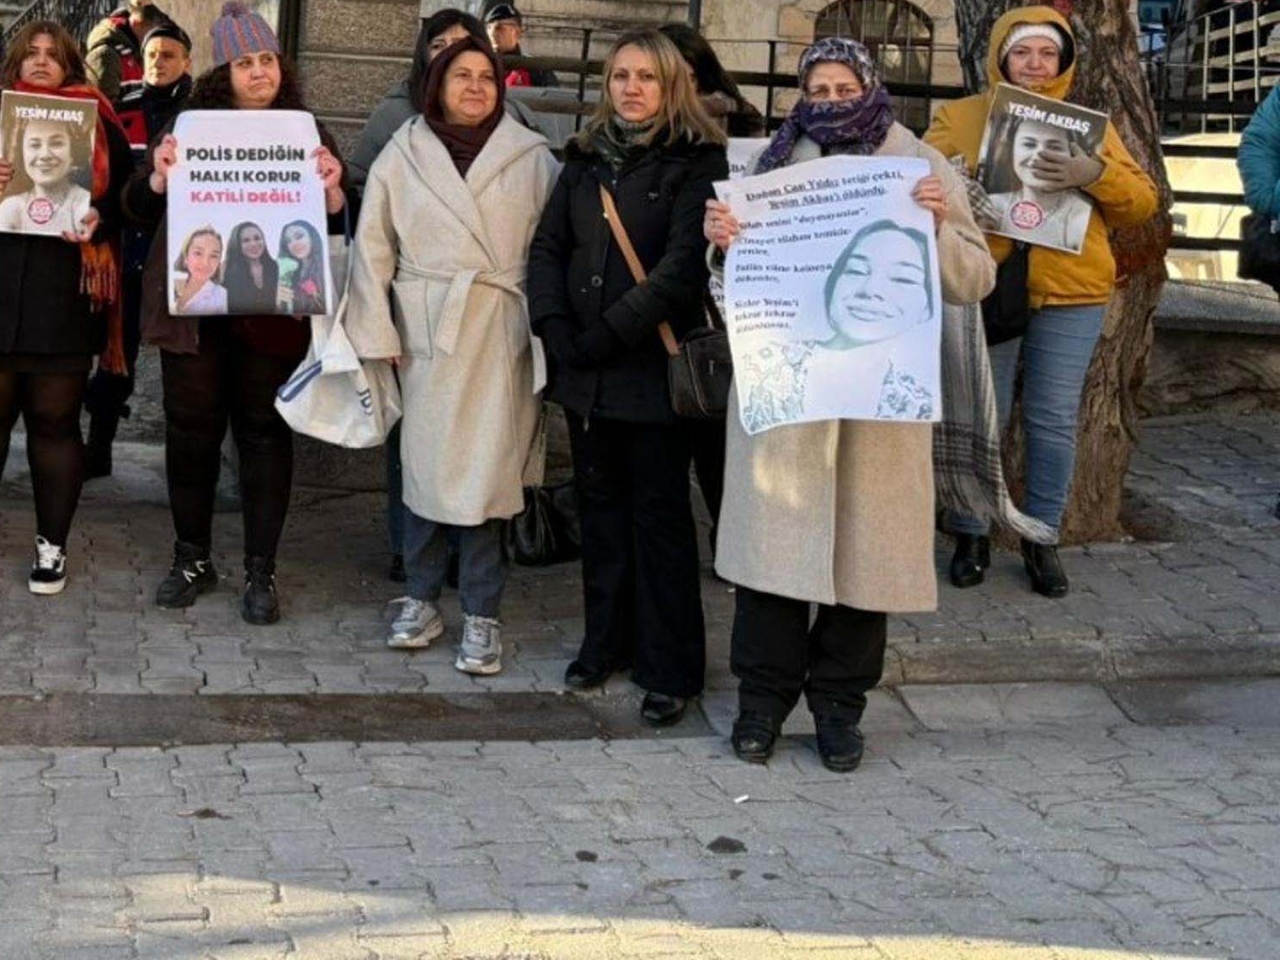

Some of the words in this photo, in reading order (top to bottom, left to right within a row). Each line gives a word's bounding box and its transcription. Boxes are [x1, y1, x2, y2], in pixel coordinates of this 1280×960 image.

[1007, 101, 1047, 123] YEŞİM
[1046, 112, 1091, 136] AKBAŞ
[186, 145, 233, 161] POLİS
[236, 144, 305, 161] DEDİĞİN
[189, 170, 239, 183] HALKI
[243, 170, 301, 183] KORUR
[190, 189, 244, 203] KATİLİ
[247, 188, 301, 203] DEĞİL!
